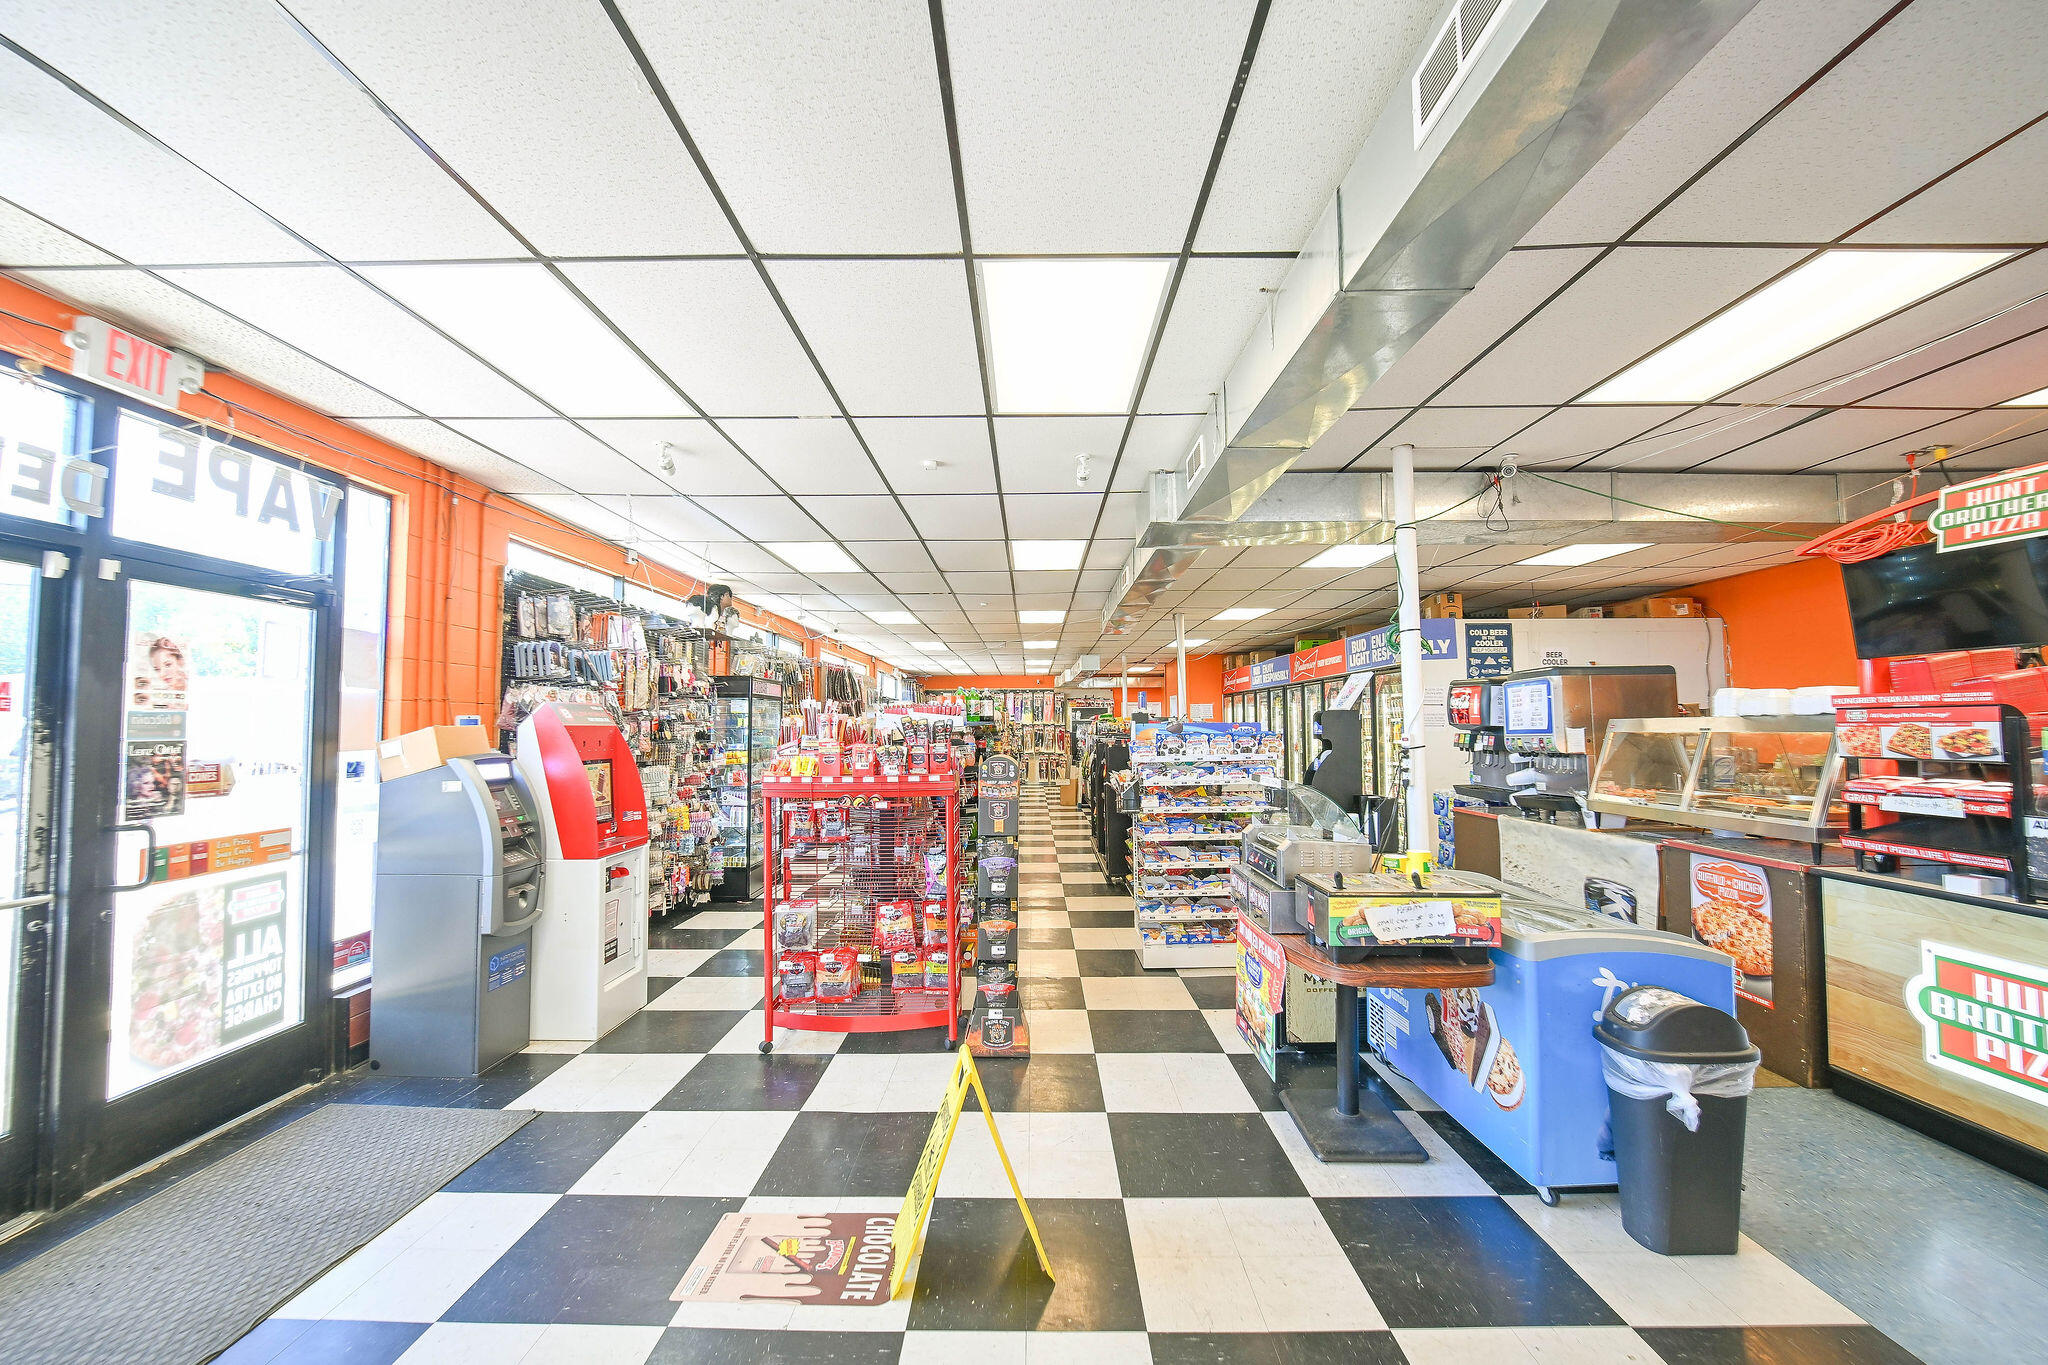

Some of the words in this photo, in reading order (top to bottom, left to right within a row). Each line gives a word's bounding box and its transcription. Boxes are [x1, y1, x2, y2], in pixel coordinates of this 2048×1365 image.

[105, 327, 173, 397] EXIT
[1966, 477, 2040, 506] HUNT
[1964, 512, 2040, 539] PIZZA
[1351, 638, 1366, 653] BUD
[1349, 650, 1371, 667] LIGHT
[1262, 663, 1274, 673] ENJOY
[1262, 669, 1289, 683] RESPONSIBLY
[1833, 696, 1877, 705] HUNGRIER
[1844, 793, 1876, 802] GRAB
[1864, 842, 1888, 852] THAT
[1888, 845, 1921, 856] PIZZA
[1697, 871, 1726, 886] BUFFALO
[1732, 878, 1763, 896] CHICKEN
[1718, 886, 1739, 900] PIZZA
[1347, 926, 1371, 936] ORIGIN
[1457, 928, 1479, 936] CAJUN
[1259, 940, 1281, 970] PEANUTS
[1973, 972, 2048, 1021] HU
[1930, 991, 2048, 1049] BROT
[840, 1217, 896, 1302] CHOCOLATE
